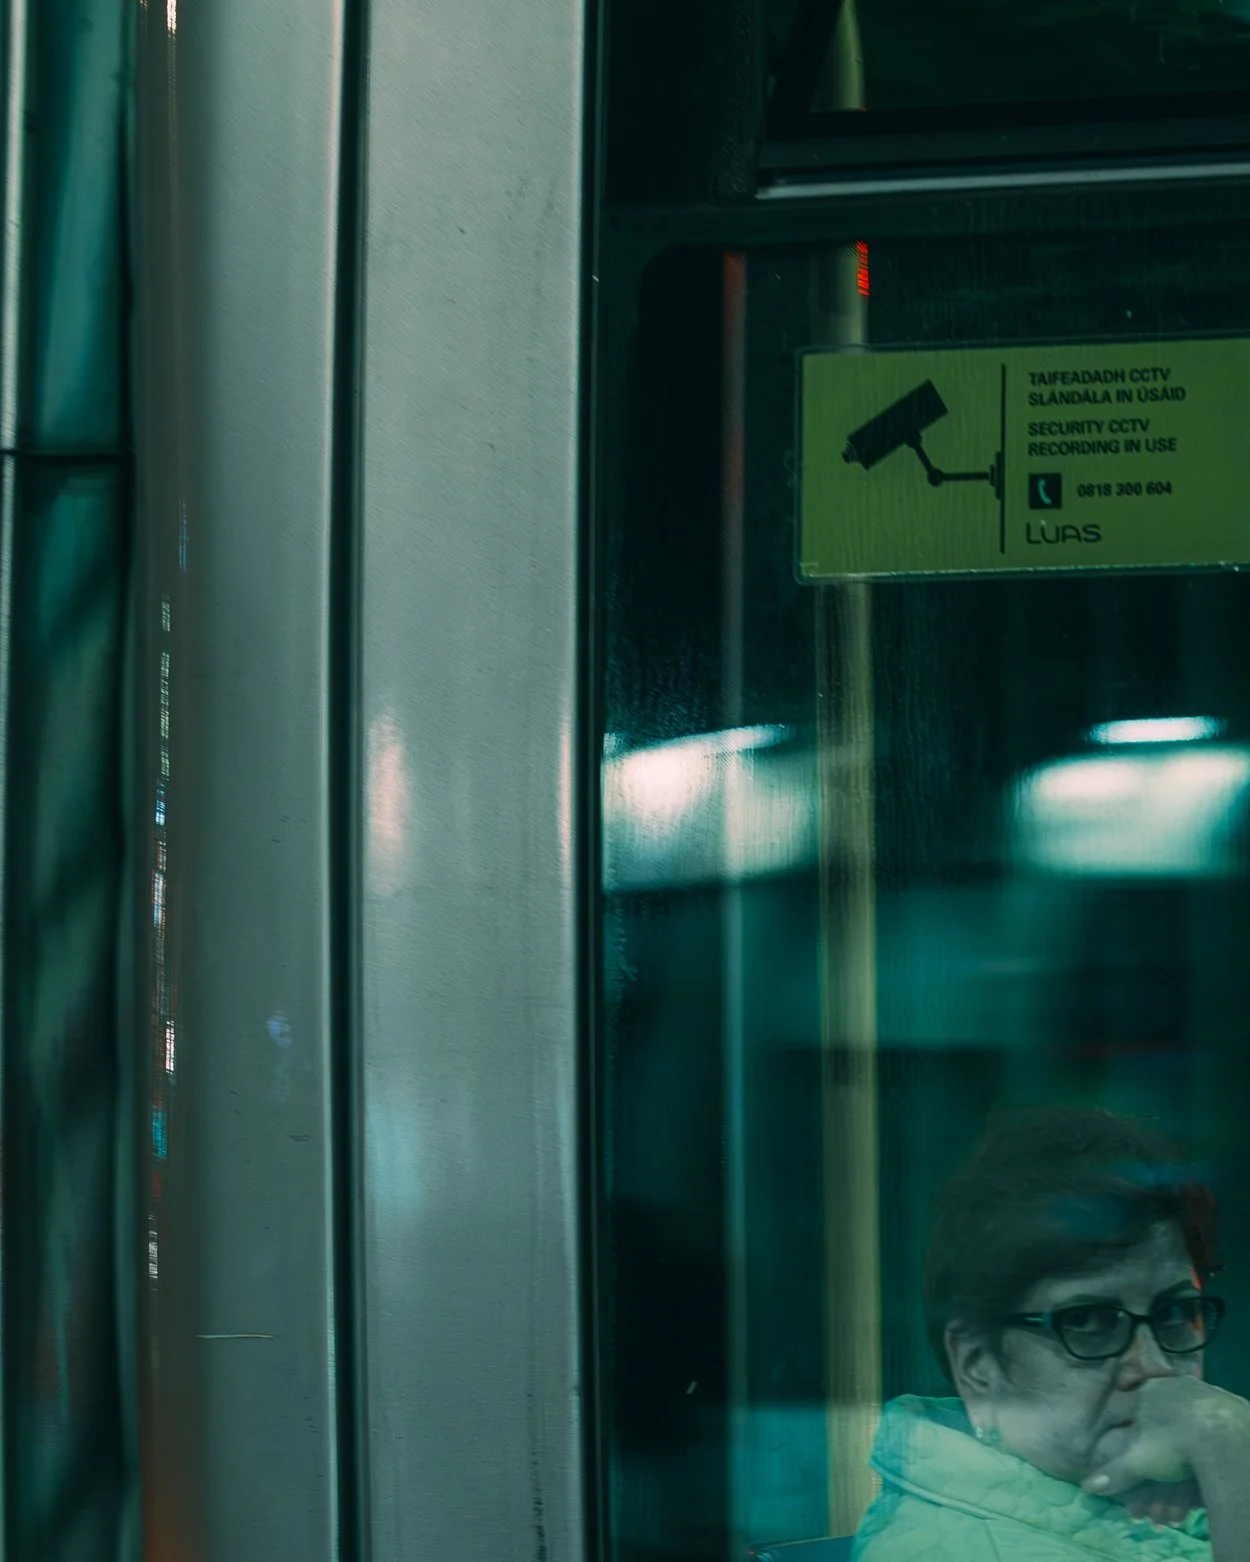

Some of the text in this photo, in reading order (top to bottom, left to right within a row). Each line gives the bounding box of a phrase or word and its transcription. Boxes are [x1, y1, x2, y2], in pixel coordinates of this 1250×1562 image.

[1028, 367, 1172, 386] TAIFEADADH CCTV
[1116, 389, 1133, 403] IN
[1028, 418, 1150, 436] SECURITY CCTV
[1028, 437, 1177, 456] RECORDING IN USE
[1077, 481, 1172, 497] 0818 300 604
[1026, 522, 1102, 544] LUAS
